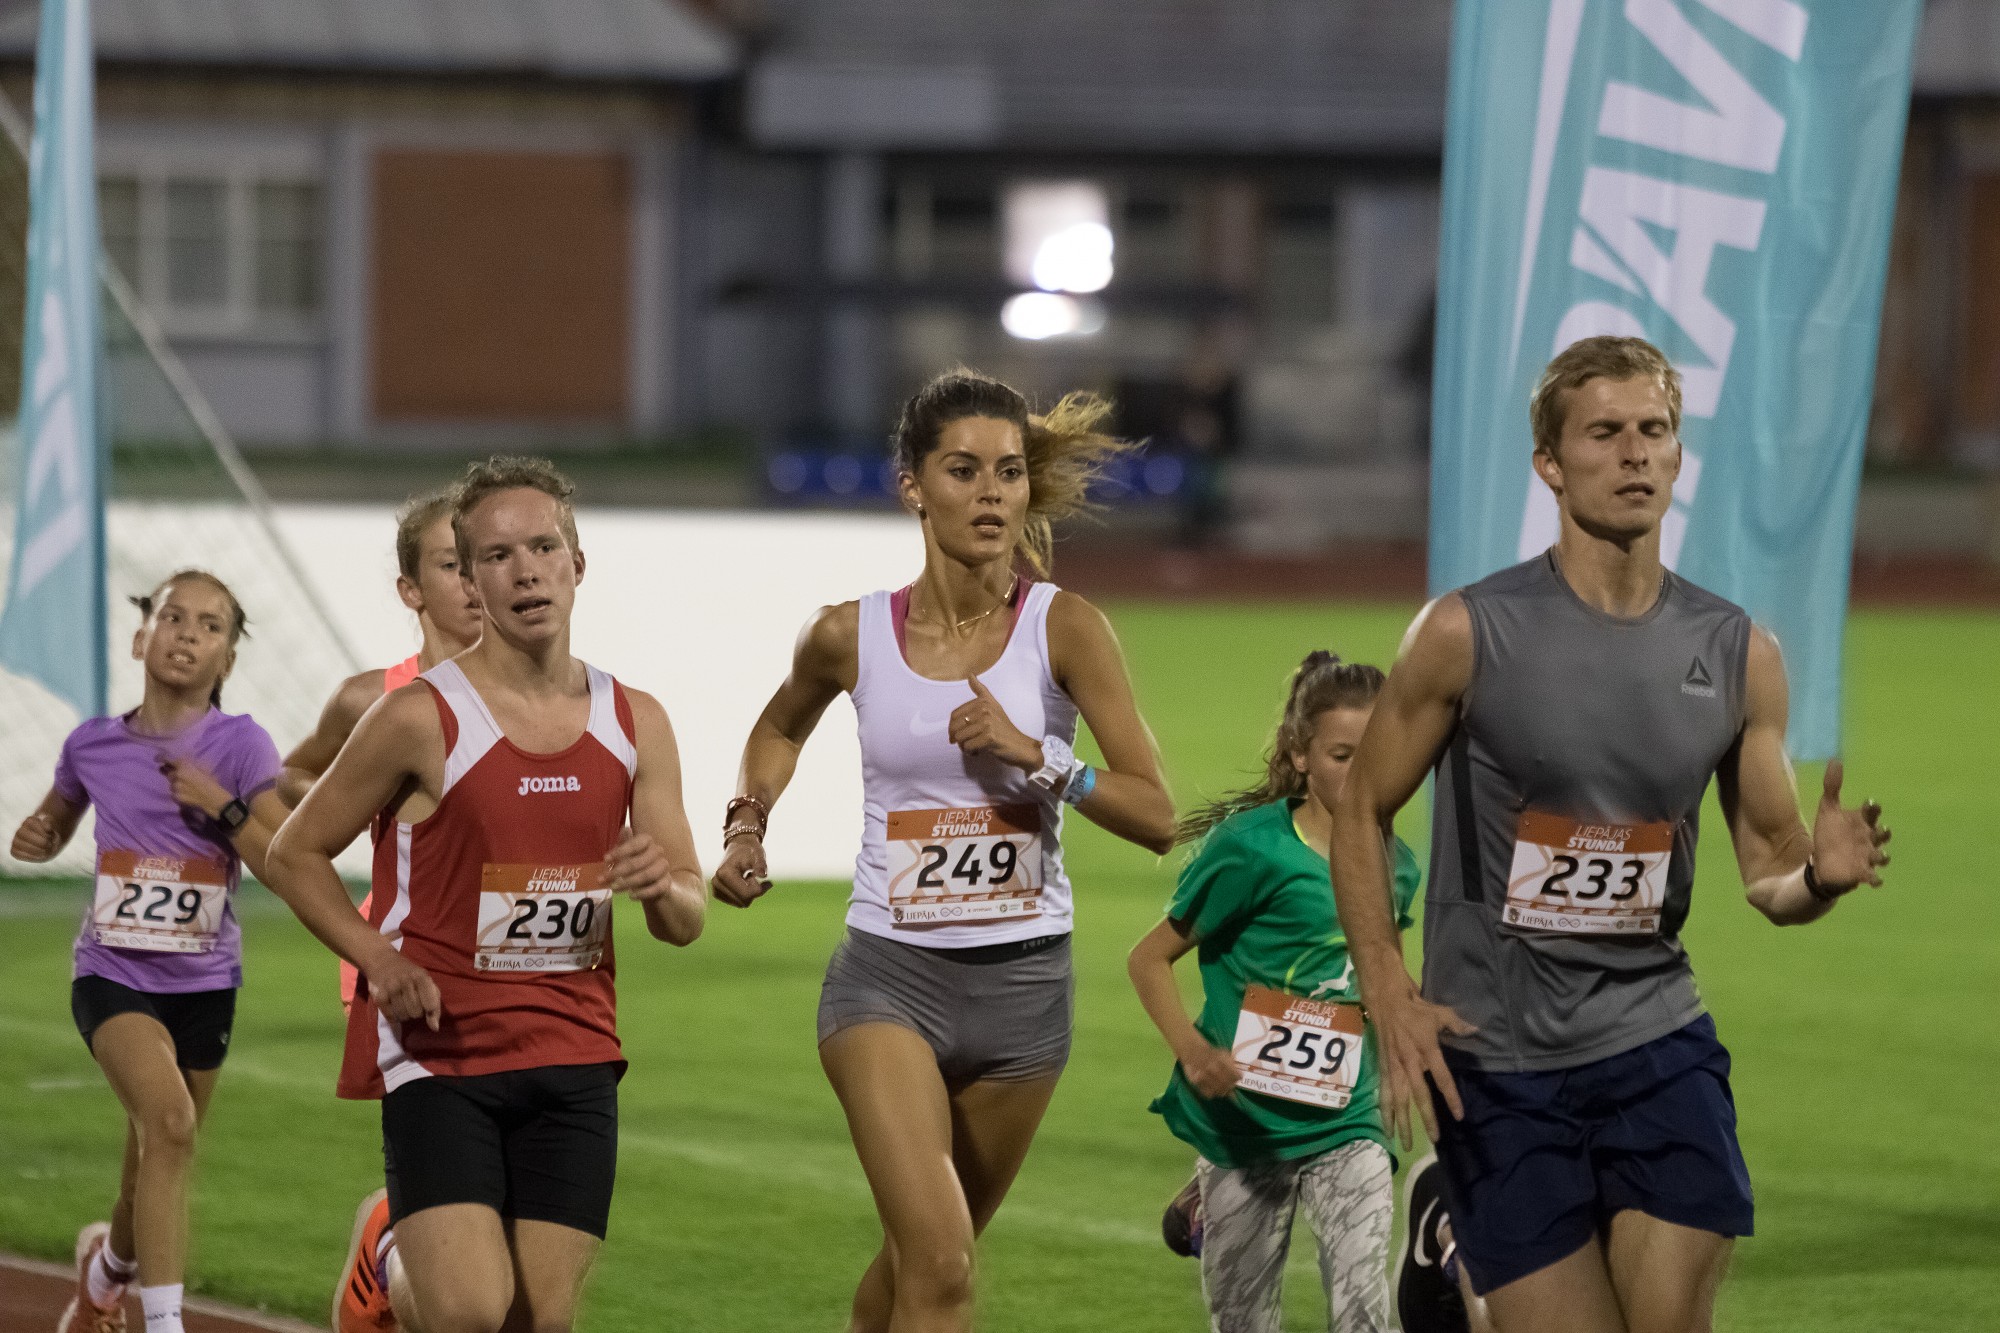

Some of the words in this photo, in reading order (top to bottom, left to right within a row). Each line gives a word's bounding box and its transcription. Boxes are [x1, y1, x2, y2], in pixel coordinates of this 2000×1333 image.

[1681, 684, 1716, 698] Reebok
[518, 776, 581, 796] Joma
[937, 809, 993, 825] LIEPĀJAS
[931, 822, 989, 837] STUNDA
[1575, 825, 1633, 841] LIEPĀJAS
[1567, 836, 1626, 852] STUNDA
[532, 866, 581, 880] LIEPĀJAS
[917, 841, 1017, 889] 249
[132, 867, 181, 881] STUNDA
[1540, 855, 1645, 900] 233
[525, 880, 577, 892] STUNDA
[116, 883, 202, 925] 229
[506, 897, 595, 939] 230
[1282, 1009, 1332, 1028] STUNDA
[1257, 1025, 1346, 1076] 259
